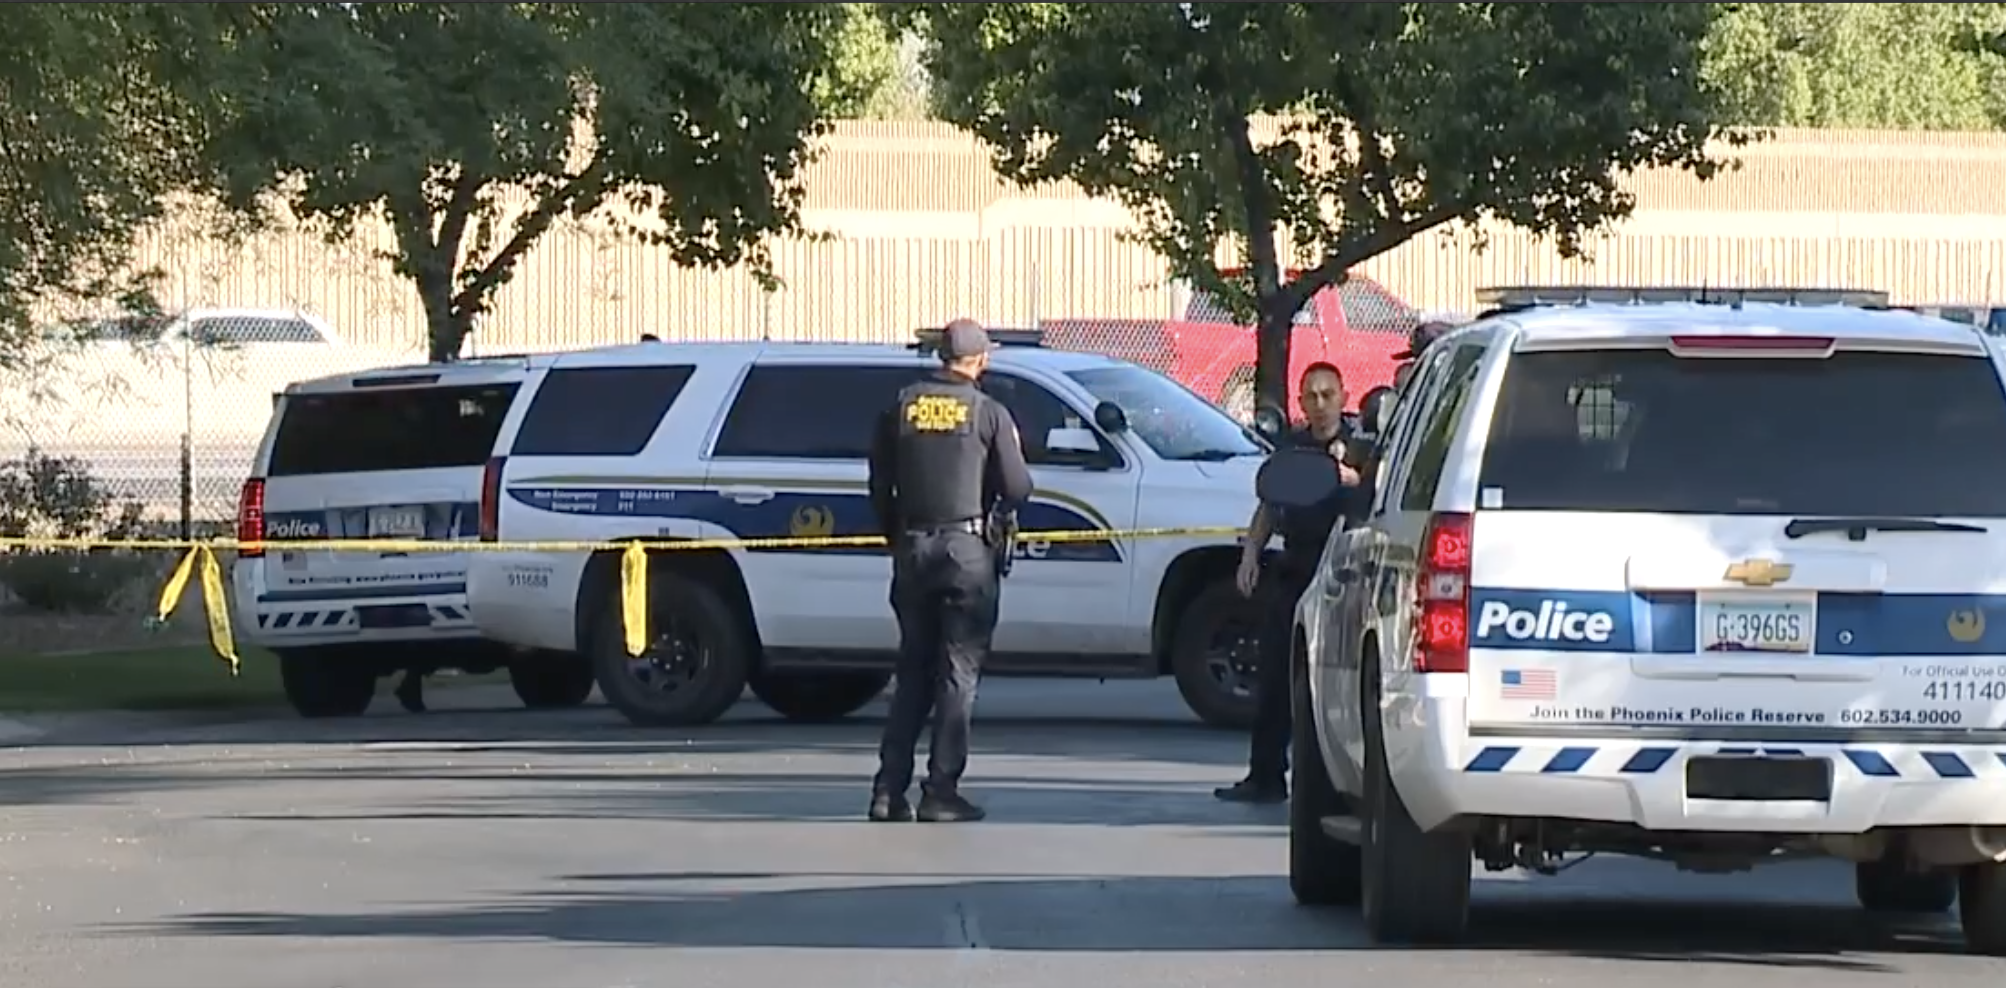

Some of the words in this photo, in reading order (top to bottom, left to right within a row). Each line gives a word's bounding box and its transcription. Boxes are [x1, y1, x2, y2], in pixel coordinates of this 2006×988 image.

[907, 404, 968, 422] POLICE
[266, 519, 321, 537] Police
[1477, 600, 1613, 642] Police
[1926, 665, 1969, 676] Official
[1972, 667, 1995, 676] Use
[1530, 706, 1569, 718] Join
[1575, 707, 1605, 718] the
[1611, 708, 1684, 721] Phoenix
[1690, 708, 1746, 722] Police
[1751, 709, 1826, 722] Reserve
[1840, 709, 1962, 724] 602.534.9000
